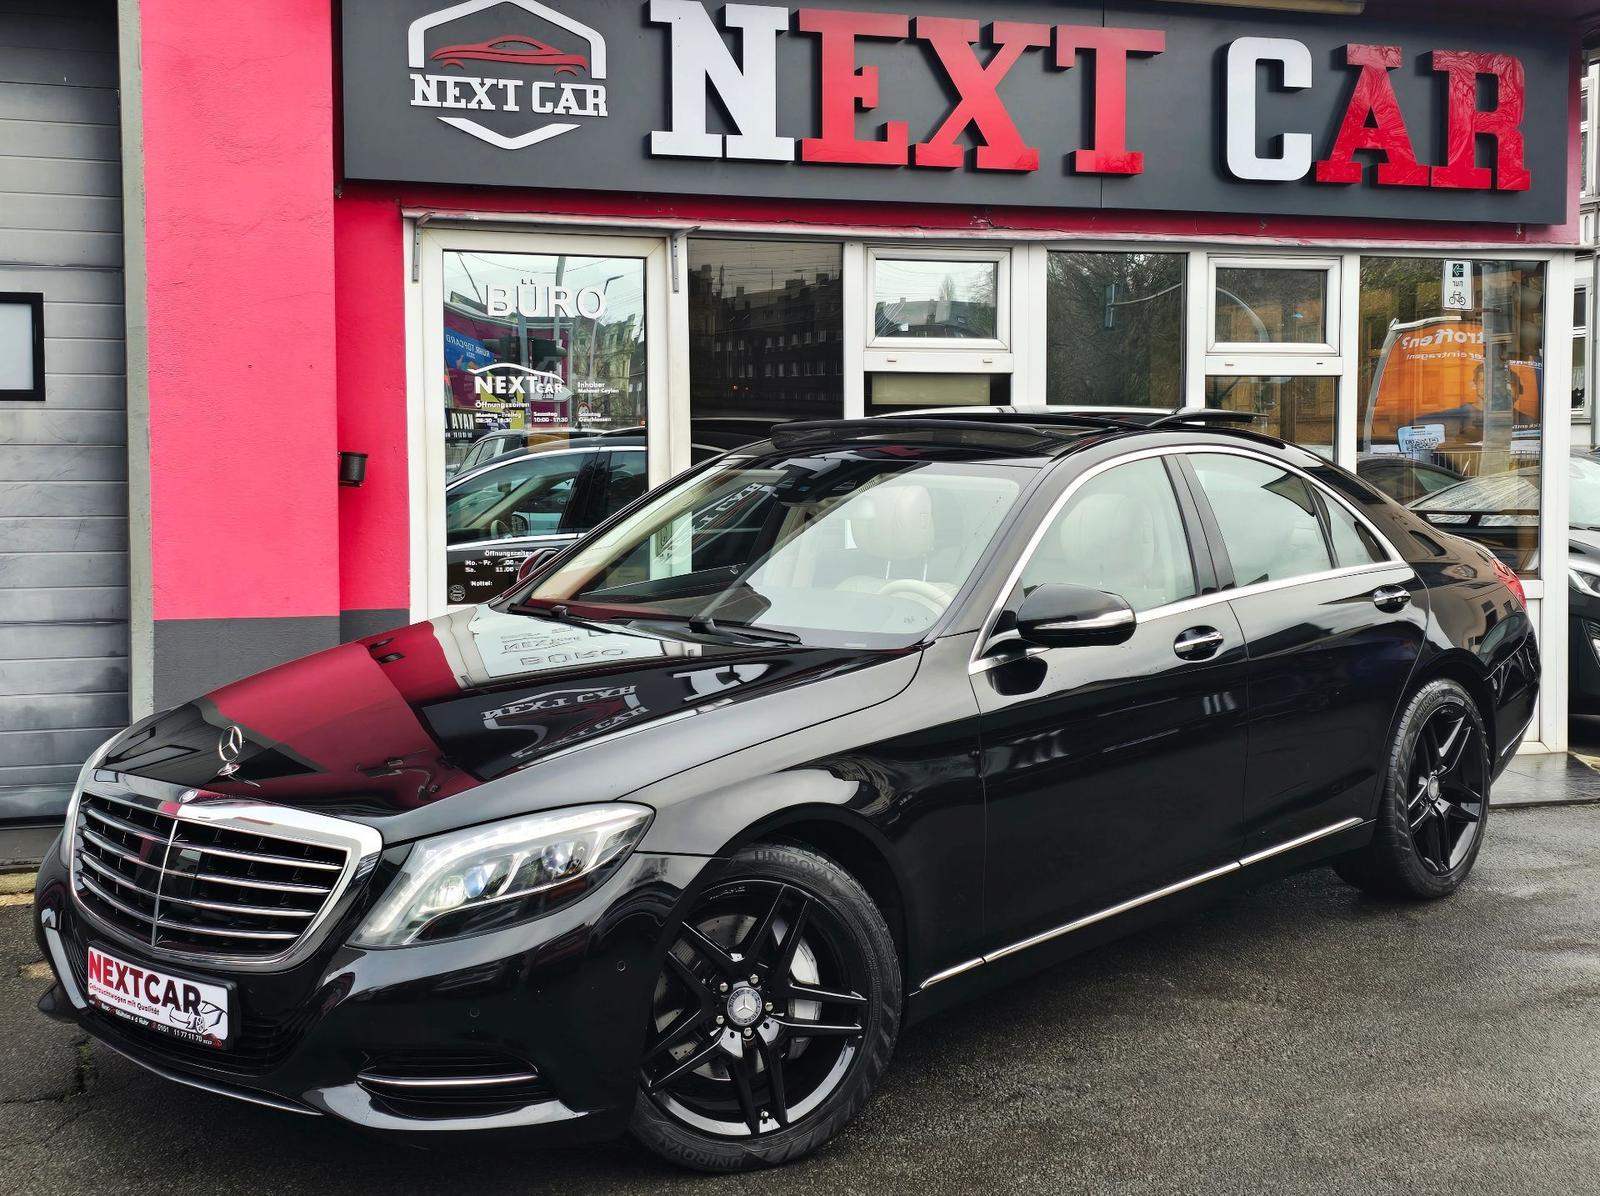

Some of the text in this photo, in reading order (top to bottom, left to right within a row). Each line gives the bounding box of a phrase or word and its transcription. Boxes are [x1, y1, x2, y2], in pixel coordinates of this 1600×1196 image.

[409, 73, 608, 117] NEXT CAR
[650, 0, 1532, 192] NEXT CAR
[486, 278, 607, 320] BÜRO
[475, 399, 530, 410] Öffnungszeiten
[89, 950, 202, 1016] NEXTCAR
